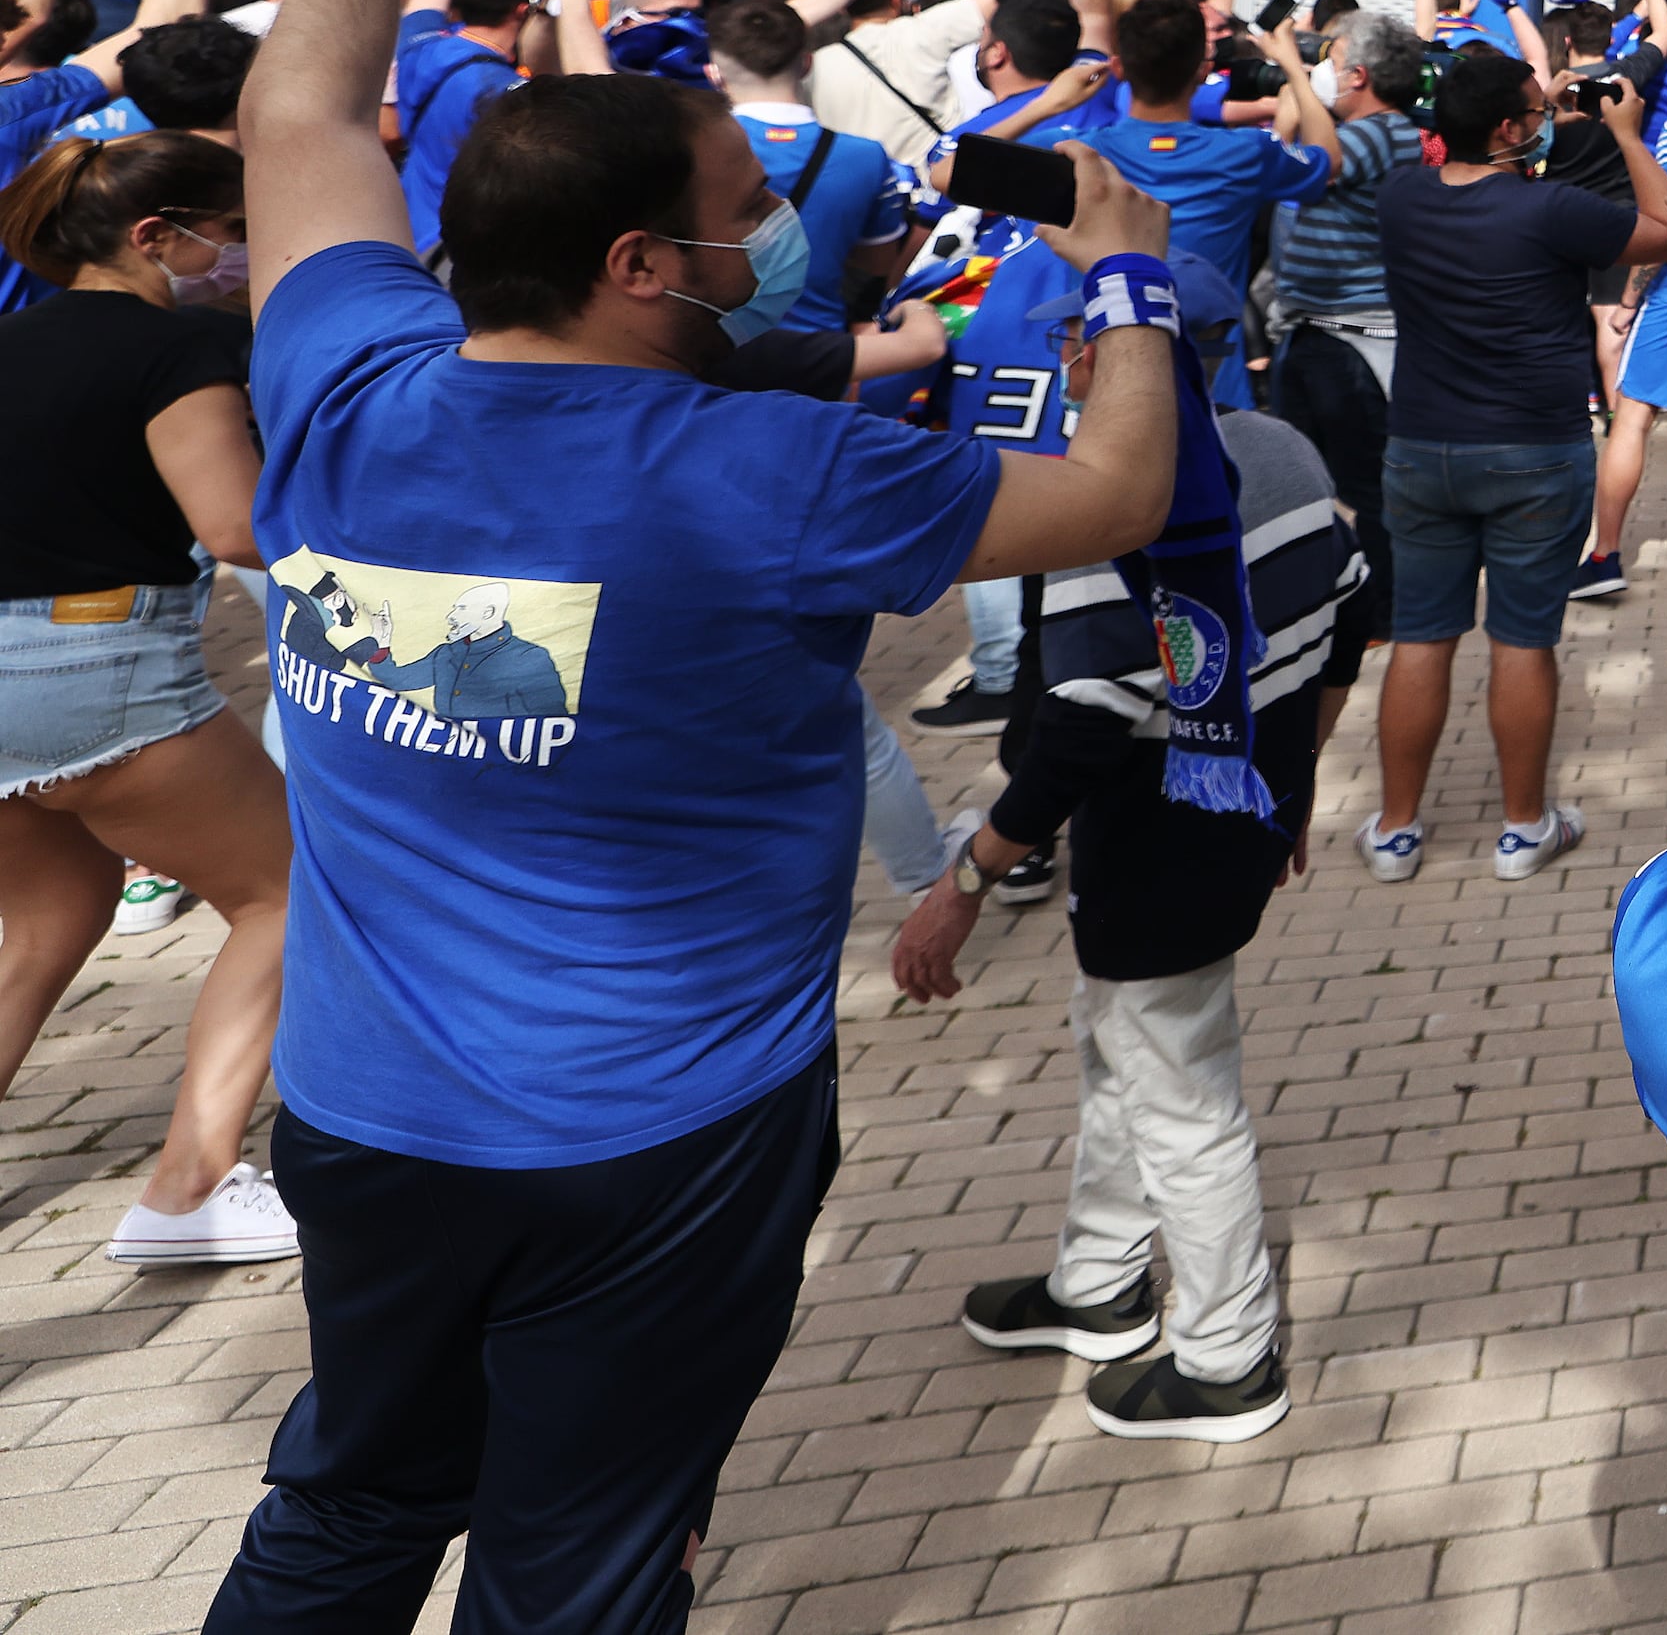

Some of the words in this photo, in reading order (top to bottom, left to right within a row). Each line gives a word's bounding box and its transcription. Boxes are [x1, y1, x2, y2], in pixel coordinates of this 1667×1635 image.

[276, 639, 357, 723] SHUT
[364, 684, 487, 760] THEM
[498, 716, 577, 767] UP
